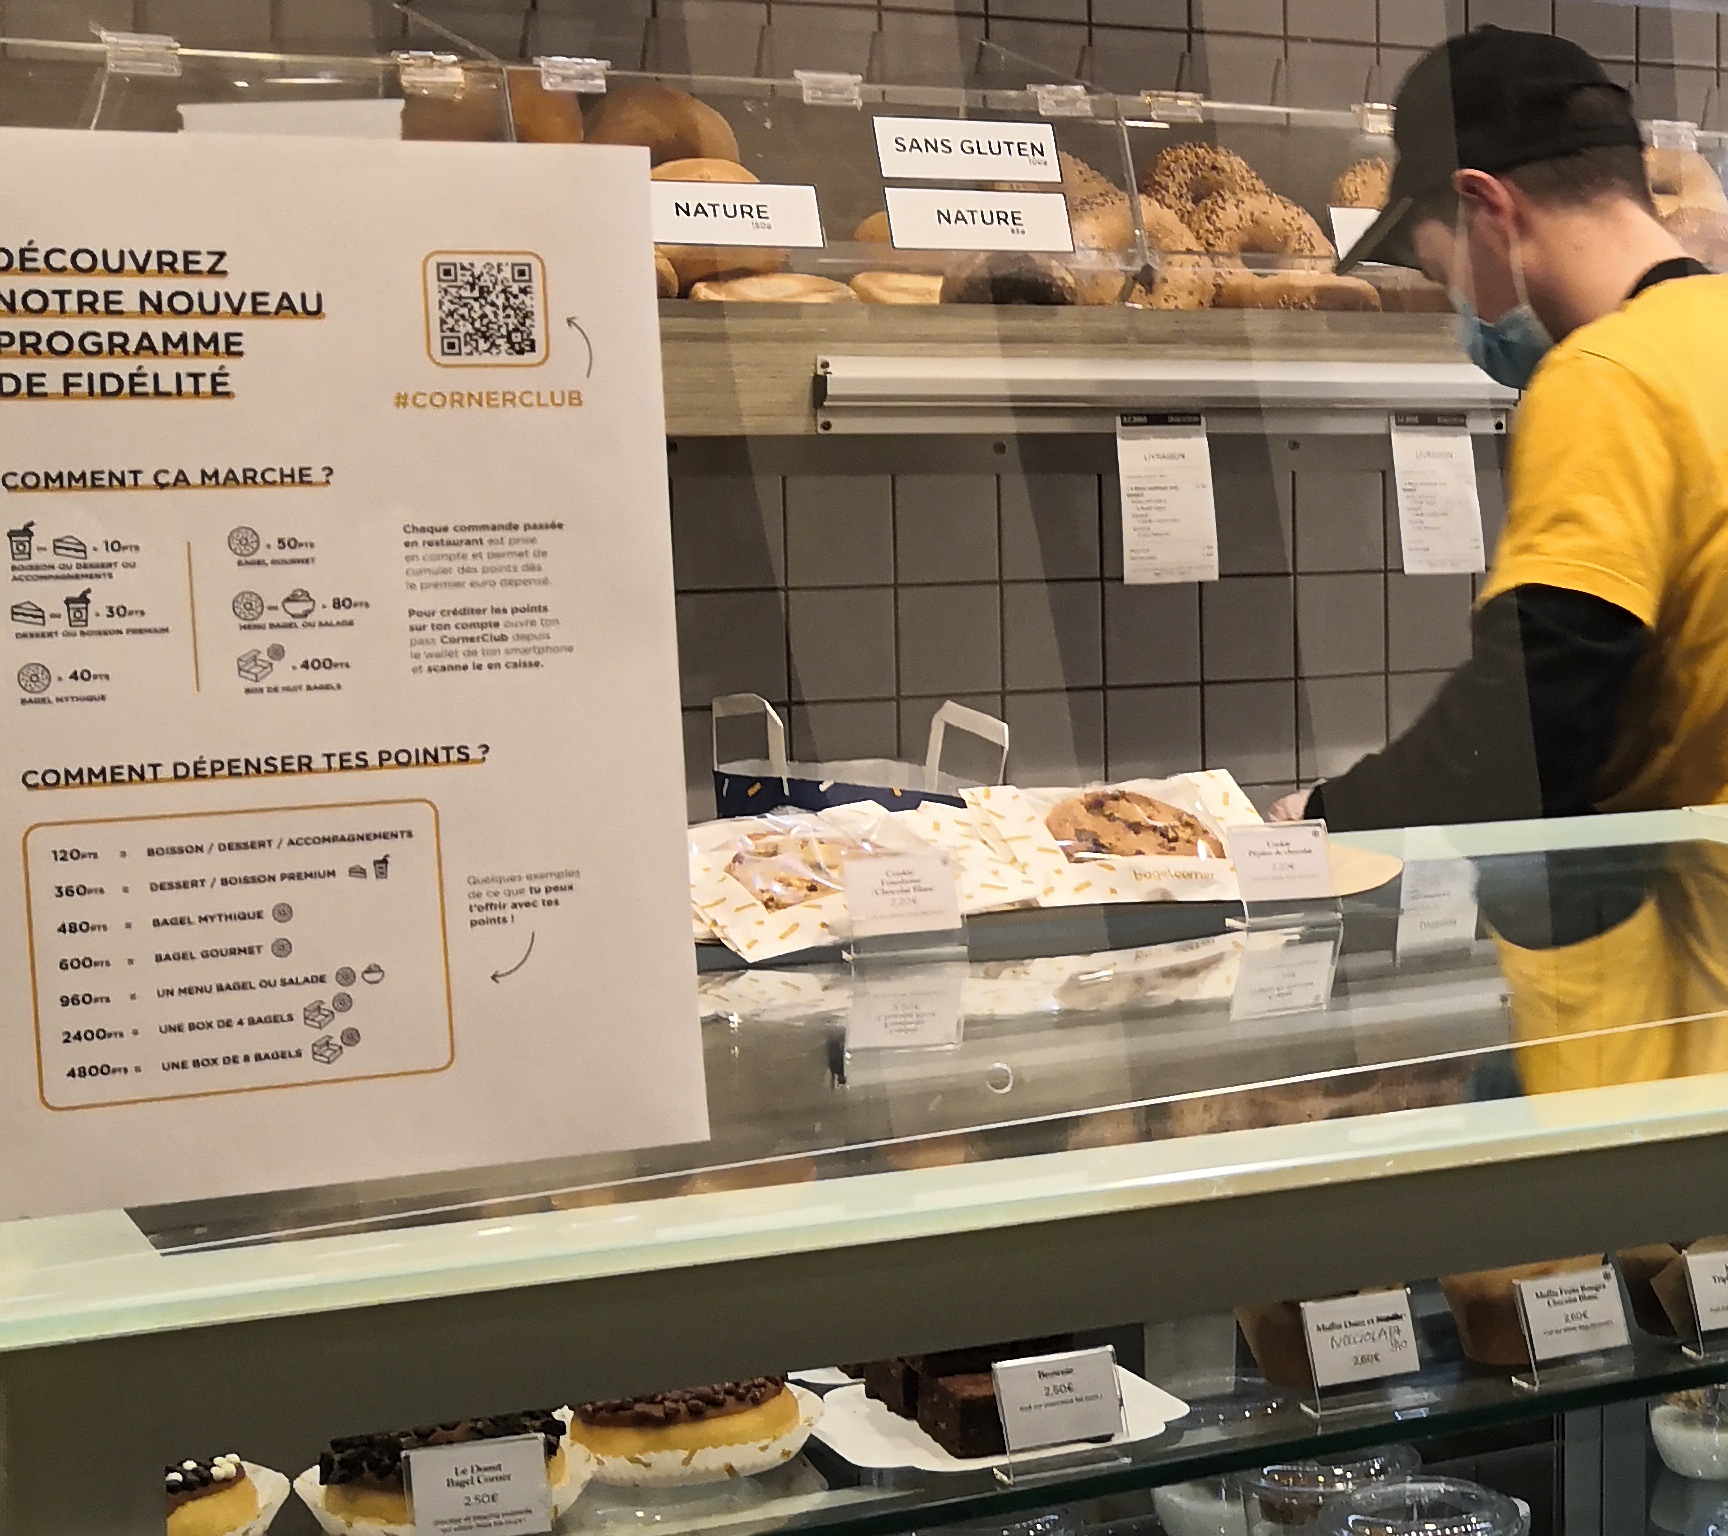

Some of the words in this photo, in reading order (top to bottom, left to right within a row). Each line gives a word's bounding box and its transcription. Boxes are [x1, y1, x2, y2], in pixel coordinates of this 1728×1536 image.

[893, 135, 954, 157] SANS
[959, 136, 1046, 160] GLUTEN
[673, 199, 771, 222] NATURE
[935, 207, 1026, 229] NATURE
[0, 289, 124, 317] NOTRE
[138, 289, 325, 317] NOUVEAU
[0, 330, 245, 358] PROGRAMME
[1, 371, 48, 398] DE
[62, 364, 233, 398] FIDÉLITÉ
[393, 389, 584, 410] #CORNERCLUB
[1, 468, 144, 491] COMMENT
[153, 468, 192, 491] ÇA
[200, 465, 314, 487] MARCHE
[21, 761, 164, 790] COMMENT
[171, 753, 314, 781] DÉPENSER
[321, 750, 370, 772] TES
[377, 744, 472, 768] POINTS
[146, 843, 206, 859] BOISSON
[217, 838, 274, 854] DESSERT
[286, 828, 415, 850] ACCOMPAGNEMENTS
[149, 876, 207, 894] DESSERT
[220, 871, 278, 888] BOISSON
[279, 867, 337, 883] PREMIUM
[151, 913, 195, 929] BAGEL
[197, 909, 265, 927] MYTHIQUE
[154, 948, 197, 964] BAGEL
[200, 944, 264, 961] GOURMET
[178, 983, 213, 999] MENU
[215, 979, 257, 994] BAGEL
[279, 973, 328, 989] SALADE
[158, 1021, 185, 1036] UNE
[188, 1019, 215, 1034] BOX
[247, 1013, 295, 1029] BAGELS
[161, 1058, 189, 1073] UNE
[191, 1055, 219, 1070] BOX
[253, 1048, 304, 1065] BAGELS
